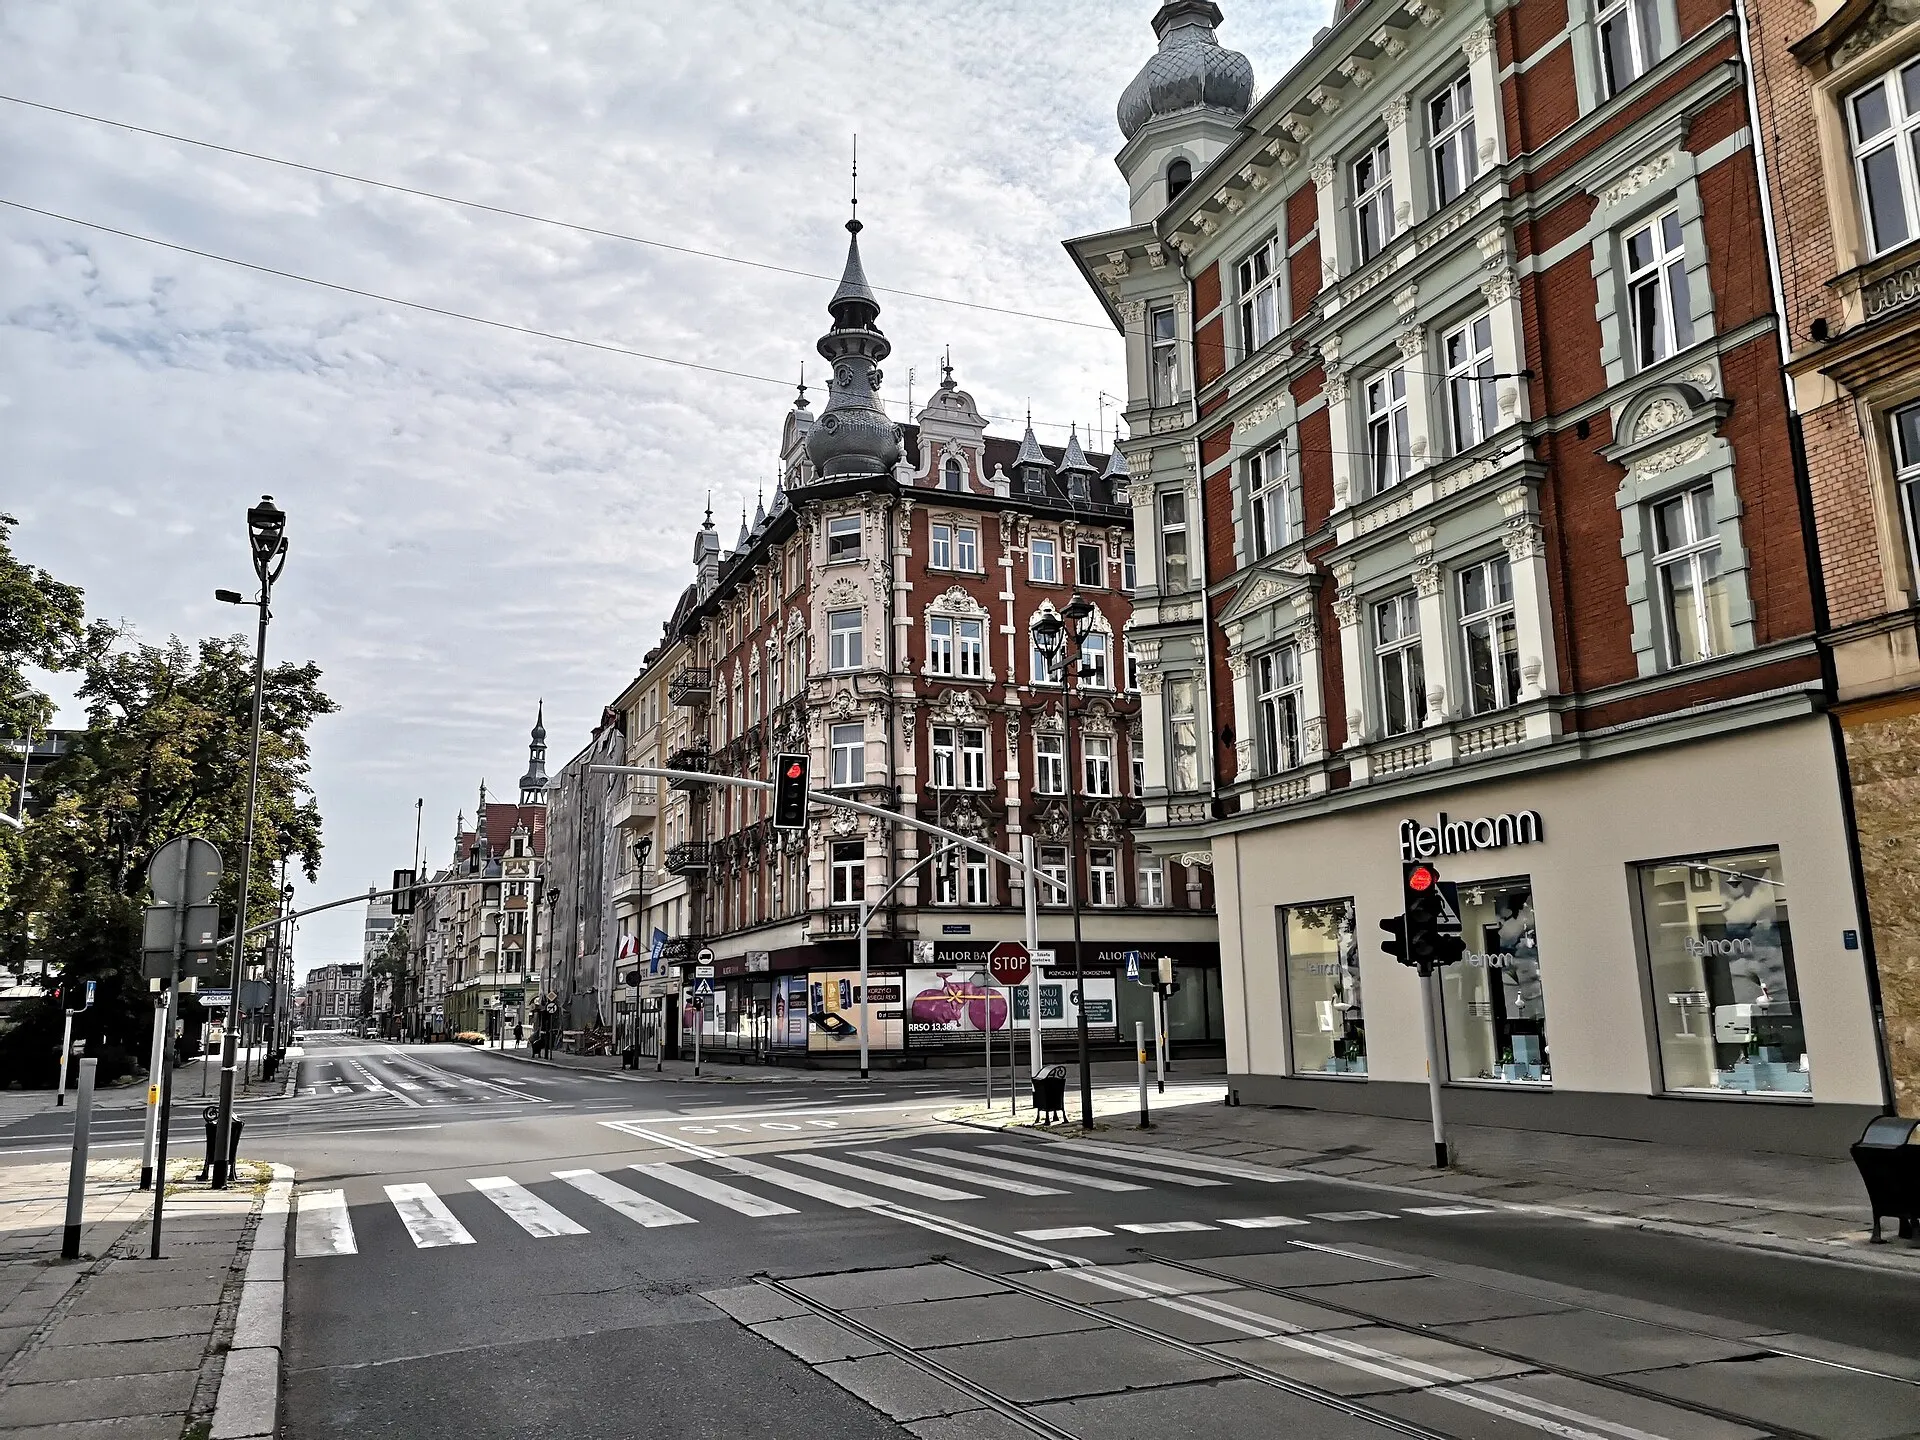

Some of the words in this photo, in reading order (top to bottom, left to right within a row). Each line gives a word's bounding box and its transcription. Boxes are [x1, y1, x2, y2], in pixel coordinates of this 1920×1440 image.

[1398, 811, 1540, 860] fielmann
[1684, 935, 1752, 957] fielmann
[937, 951, 971, 961] ALIOR
[974, 951, 989, 961] BA
[1139, 951, 1157, 960] ANK
[993, 956, 1028, 971] STOP
[1017, 998, 1058, 1007] MAENIA
[908, 1023, 930, 1032] RRSO
[679, 1119, 839, 1134] STOP
